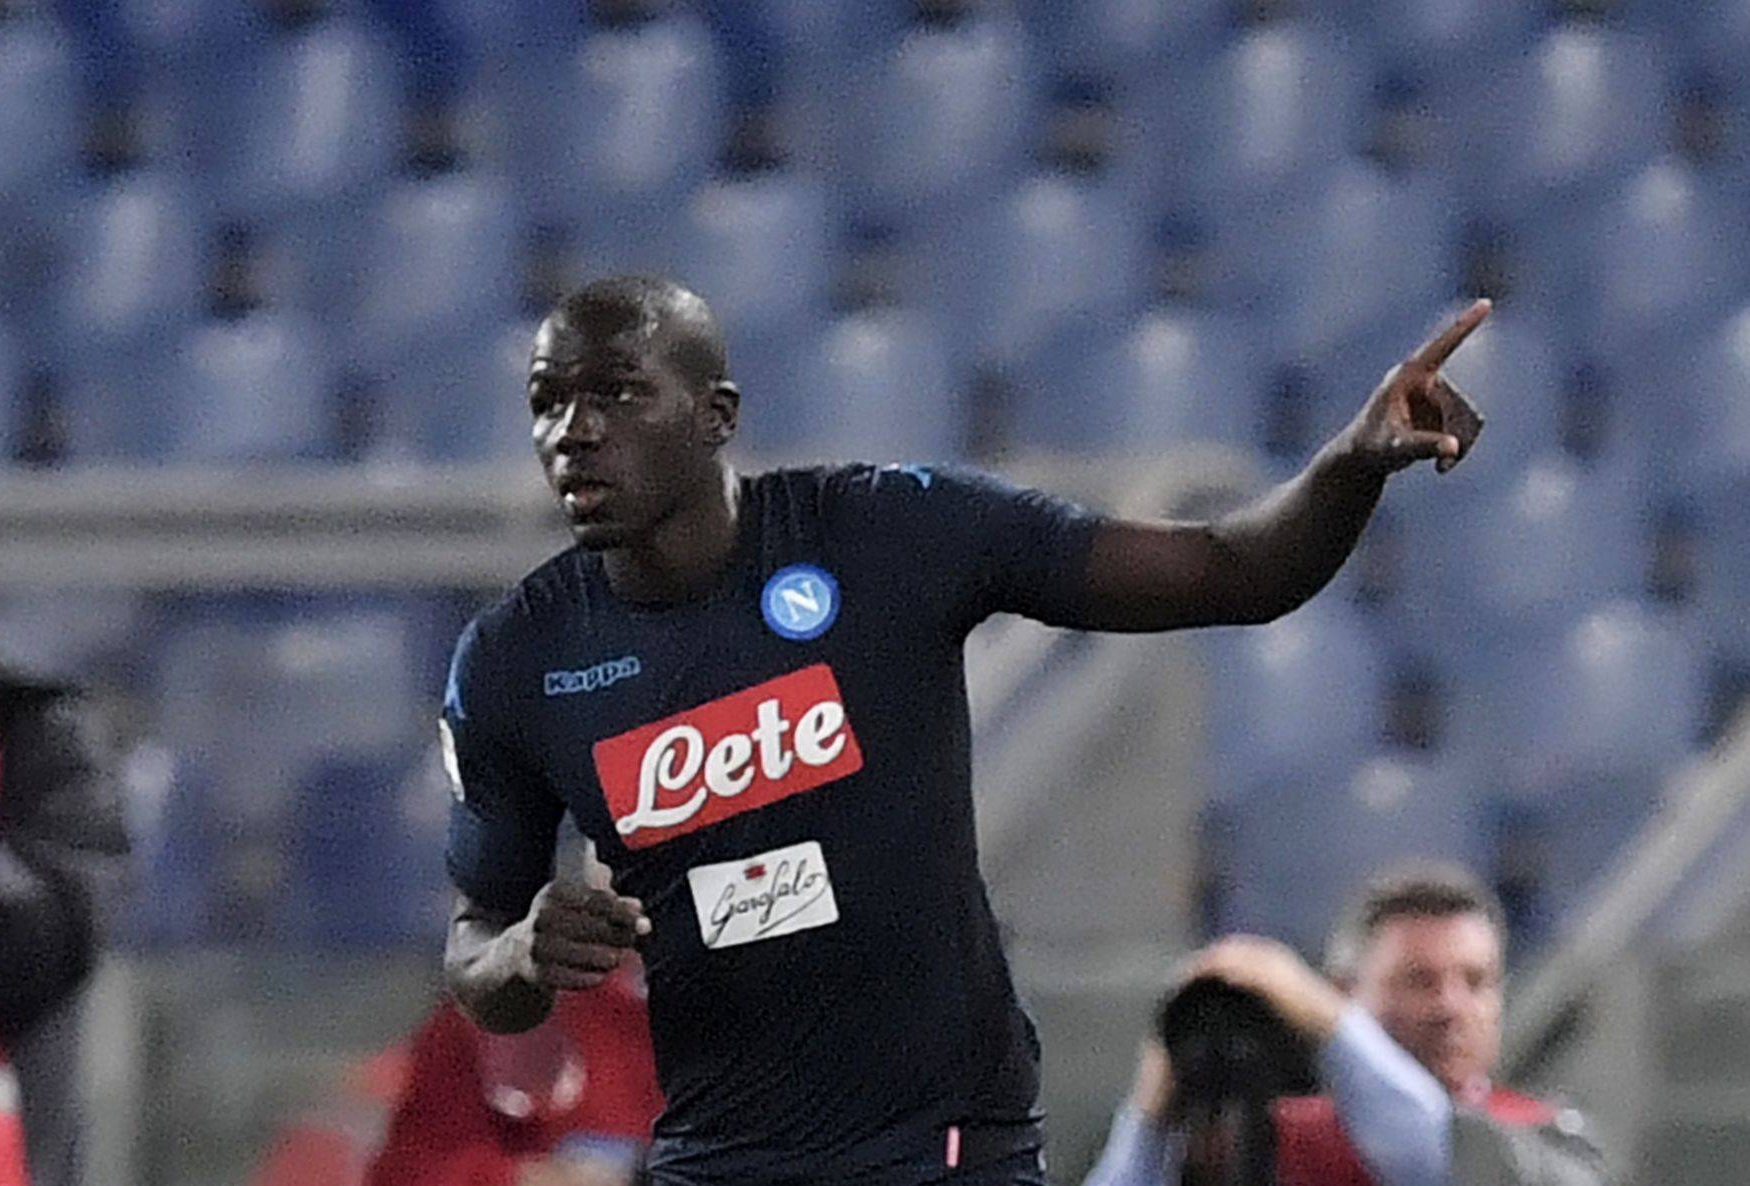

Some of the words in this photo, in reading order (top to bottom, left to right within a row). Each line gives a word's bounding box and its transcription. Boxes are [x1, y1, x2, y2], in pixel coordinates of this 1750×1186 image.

[783, 581, 819, 620] N
[545, 656, 641, 695] Kappa
[616, 698, 846, 835] Lete
[709, 858, 827, 946] Garofalo
